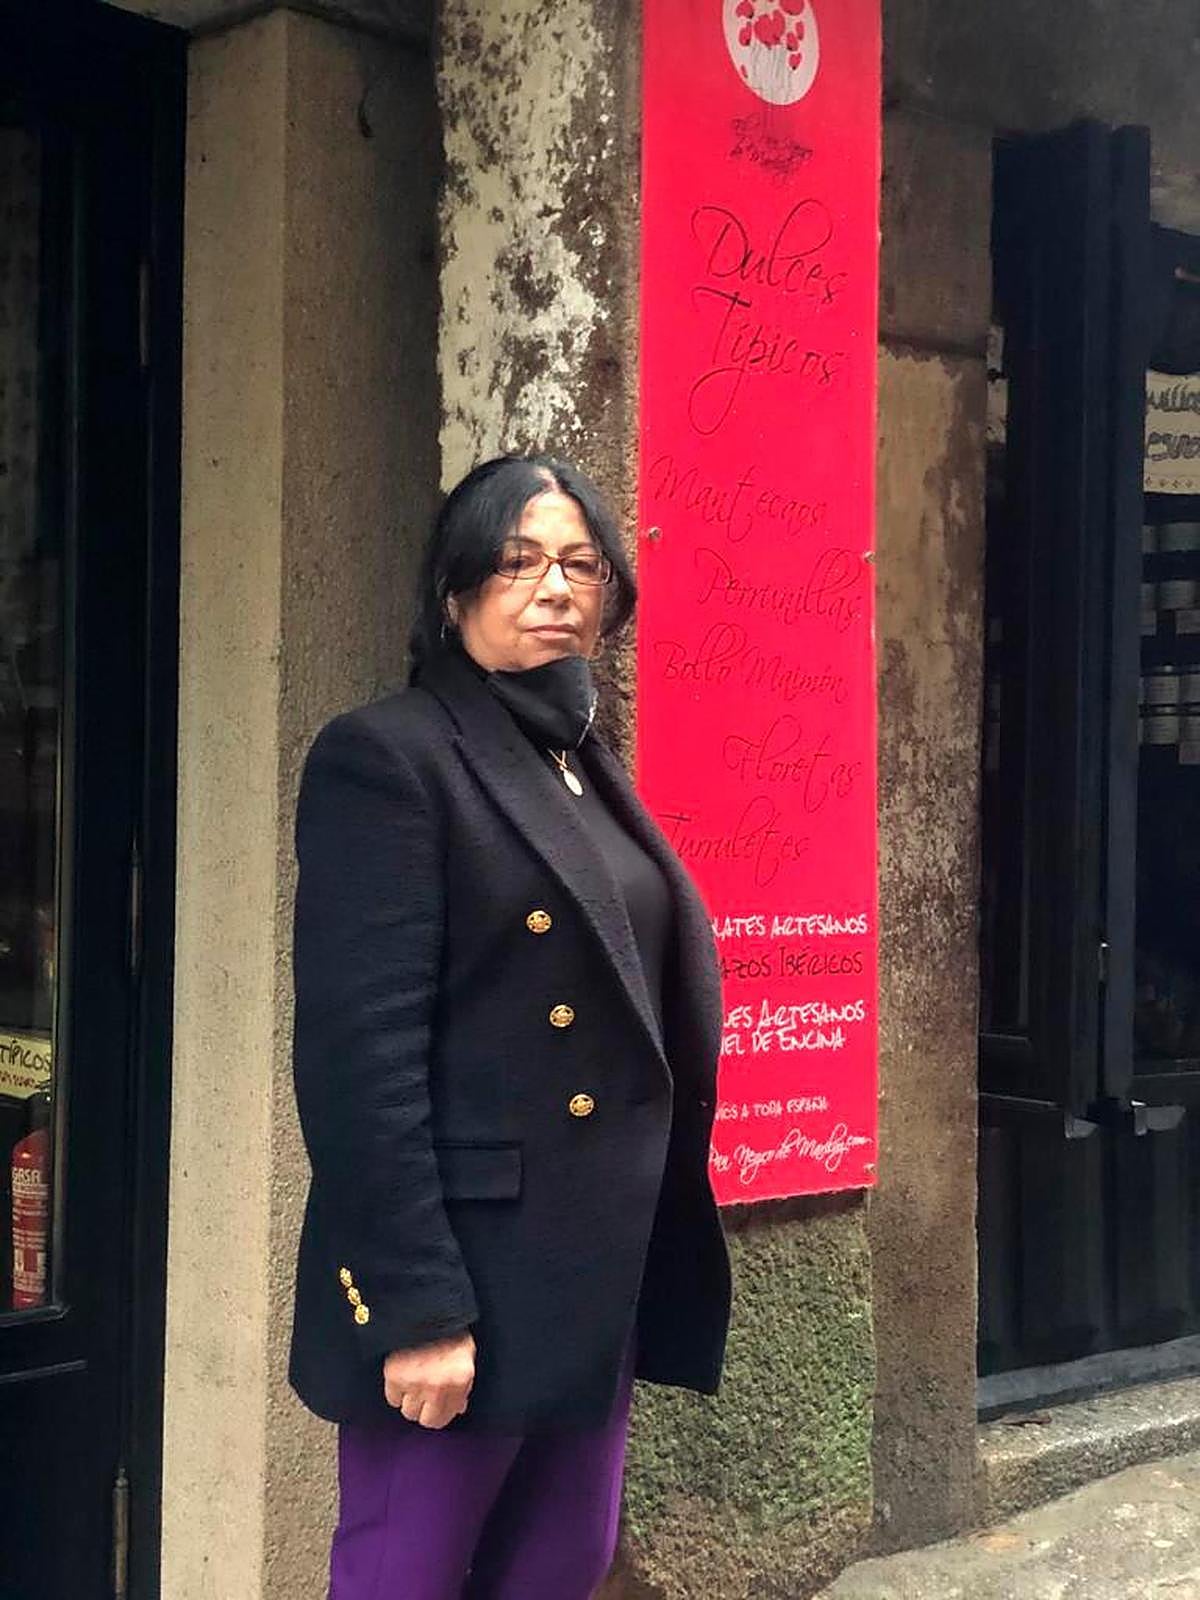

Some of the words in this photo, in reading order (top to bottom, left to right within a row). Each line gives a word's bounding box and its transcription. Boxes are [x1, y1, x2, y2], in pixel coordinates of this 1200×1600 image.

[691, 198, 848, 304] Dulces
[688, 286, 849, 436] Típicos
[653, 623, 747, 684] Bollo
[711, 914, 766, 941] LATES
[770, 914, 868, 939] ARTESANOS
[779, 946, 863, 977] IBÉRICOS
[756, 1000, 865, 1030] ARTESANOS
[752, 1027, 774, 1052] DE
[775, 1025, 846, 1051] ENCINA
